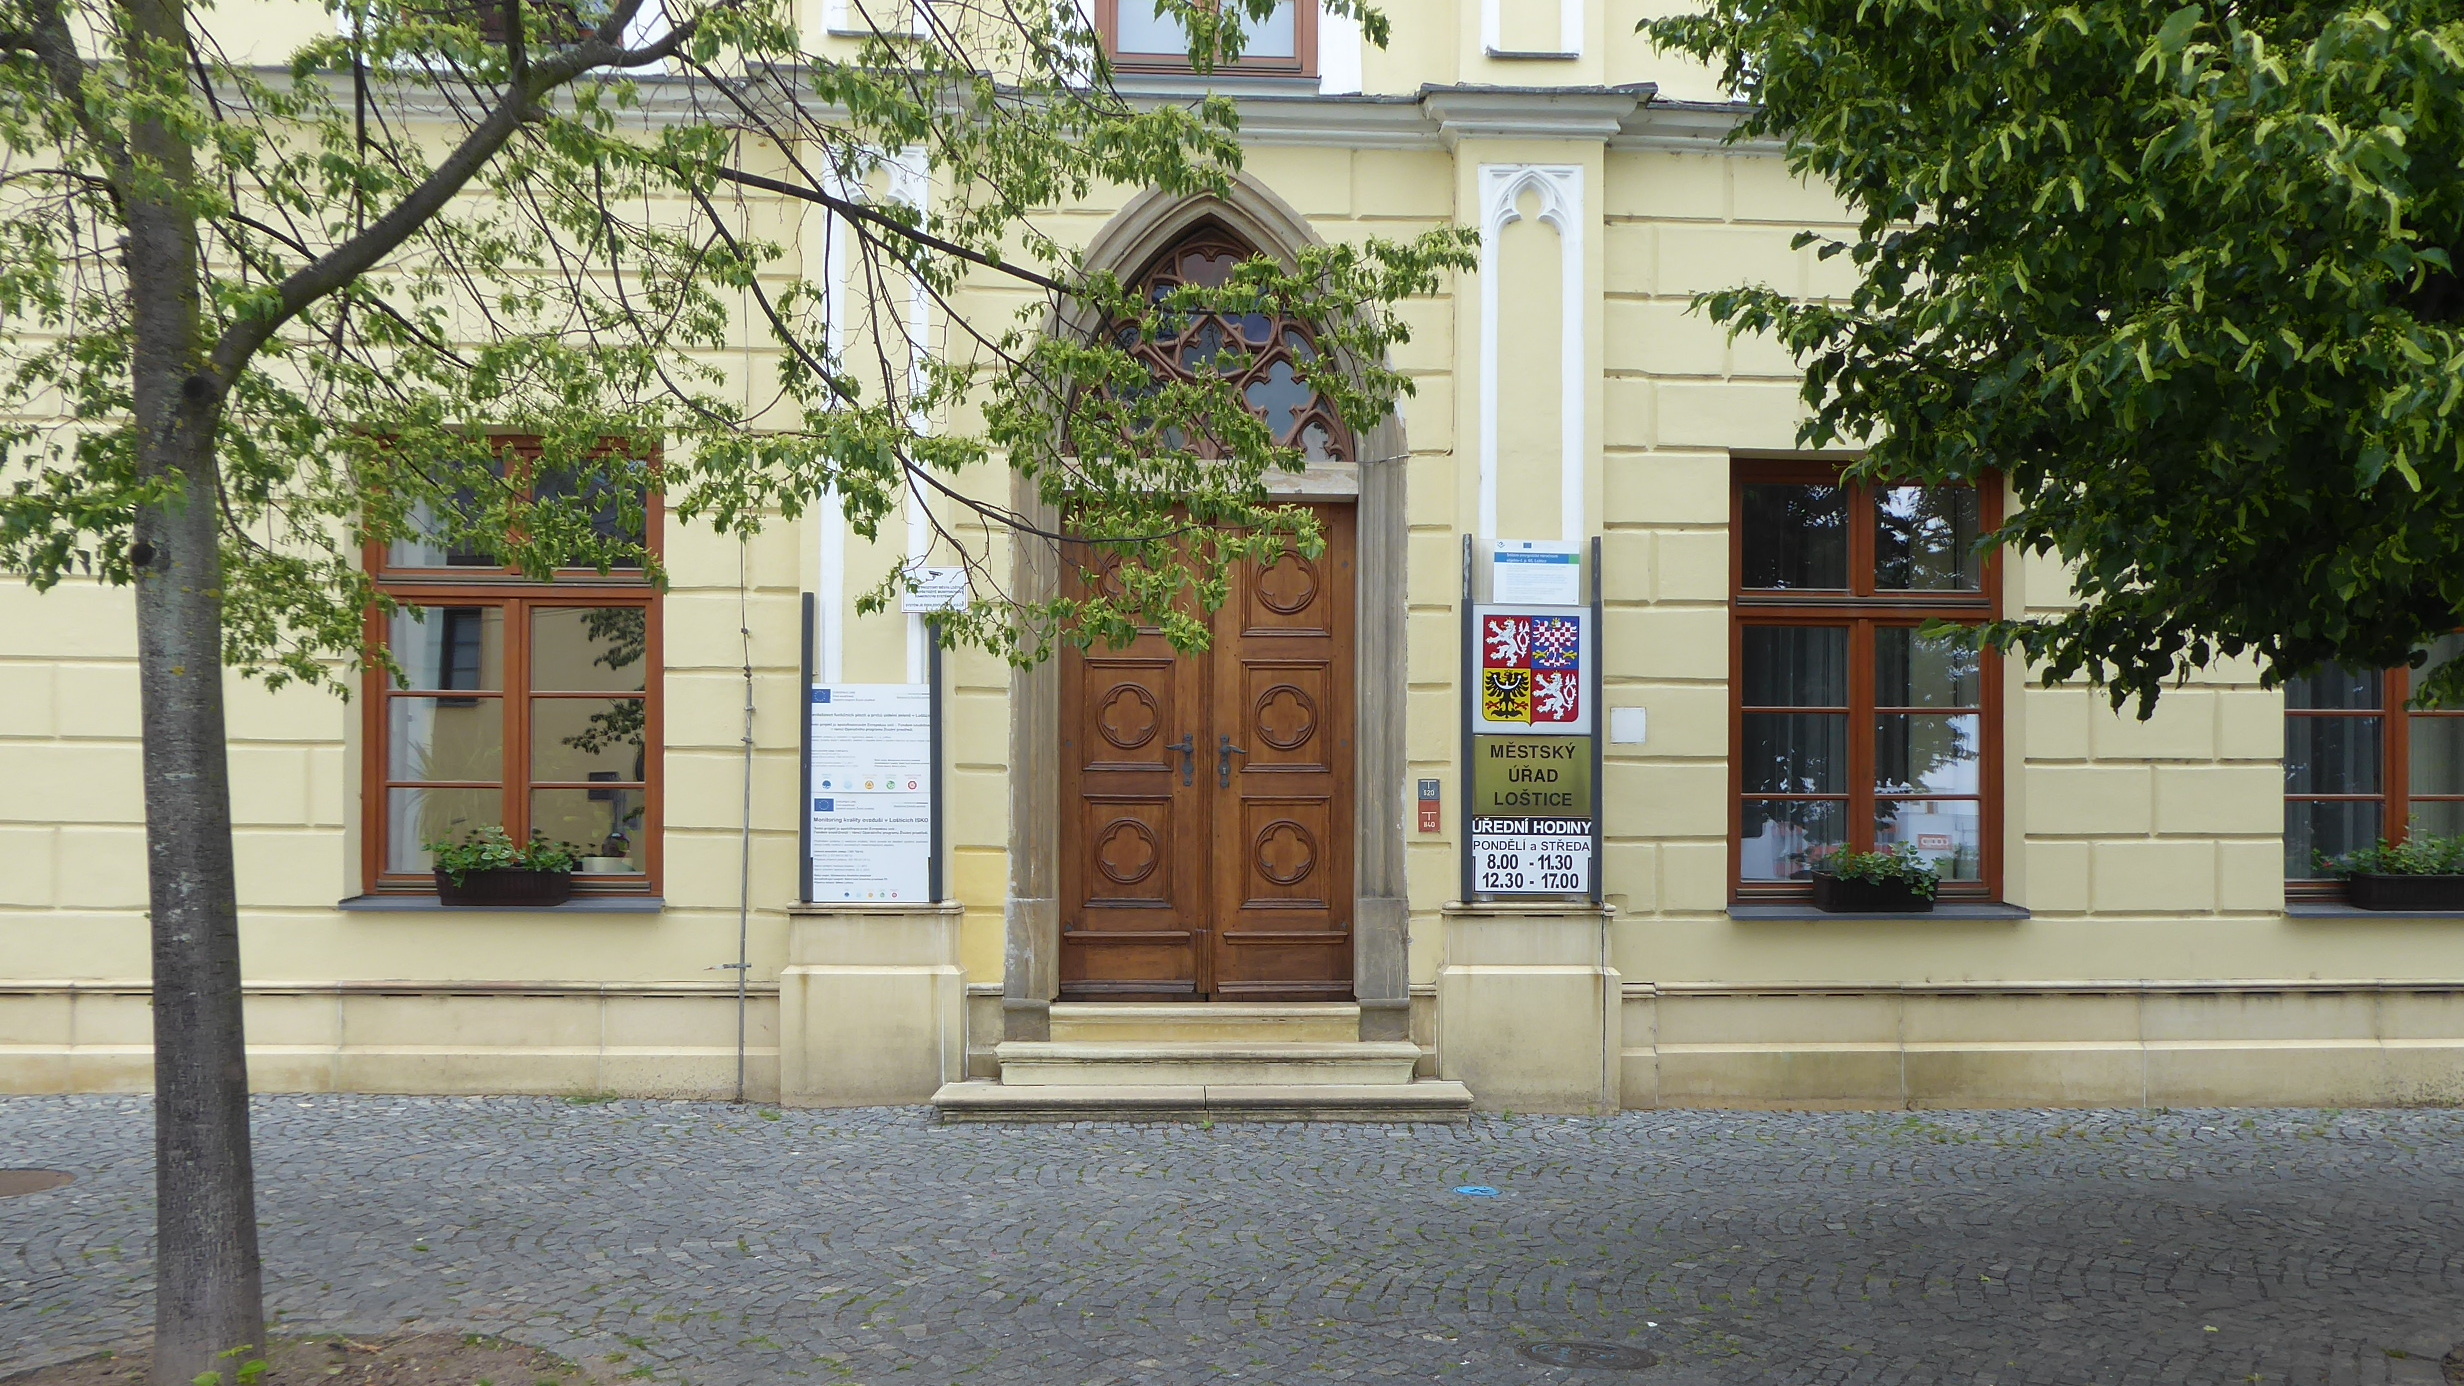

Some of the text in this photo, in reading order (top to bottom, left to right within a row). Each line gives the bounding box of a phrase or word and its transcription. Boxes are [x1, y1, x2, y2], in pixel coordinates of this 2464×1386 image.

[1490, 741, 1576, 759] MĚSTSKÝ
[1509, 765, 1559, 782] ÚŘAD
[1494, 789, 1572, 806] LOŠTICE
[1472, 817, 1592, 835] ÚŘEDNÍ HODINY
[1473, 838, 1590, 851] PONDĚLÍ a STŘEDA
[1487, 854, 1518, 869] 8.00
[1482, 872, 1524, 888] 12.30
[1541, 873, 1579, 889] 17.00
